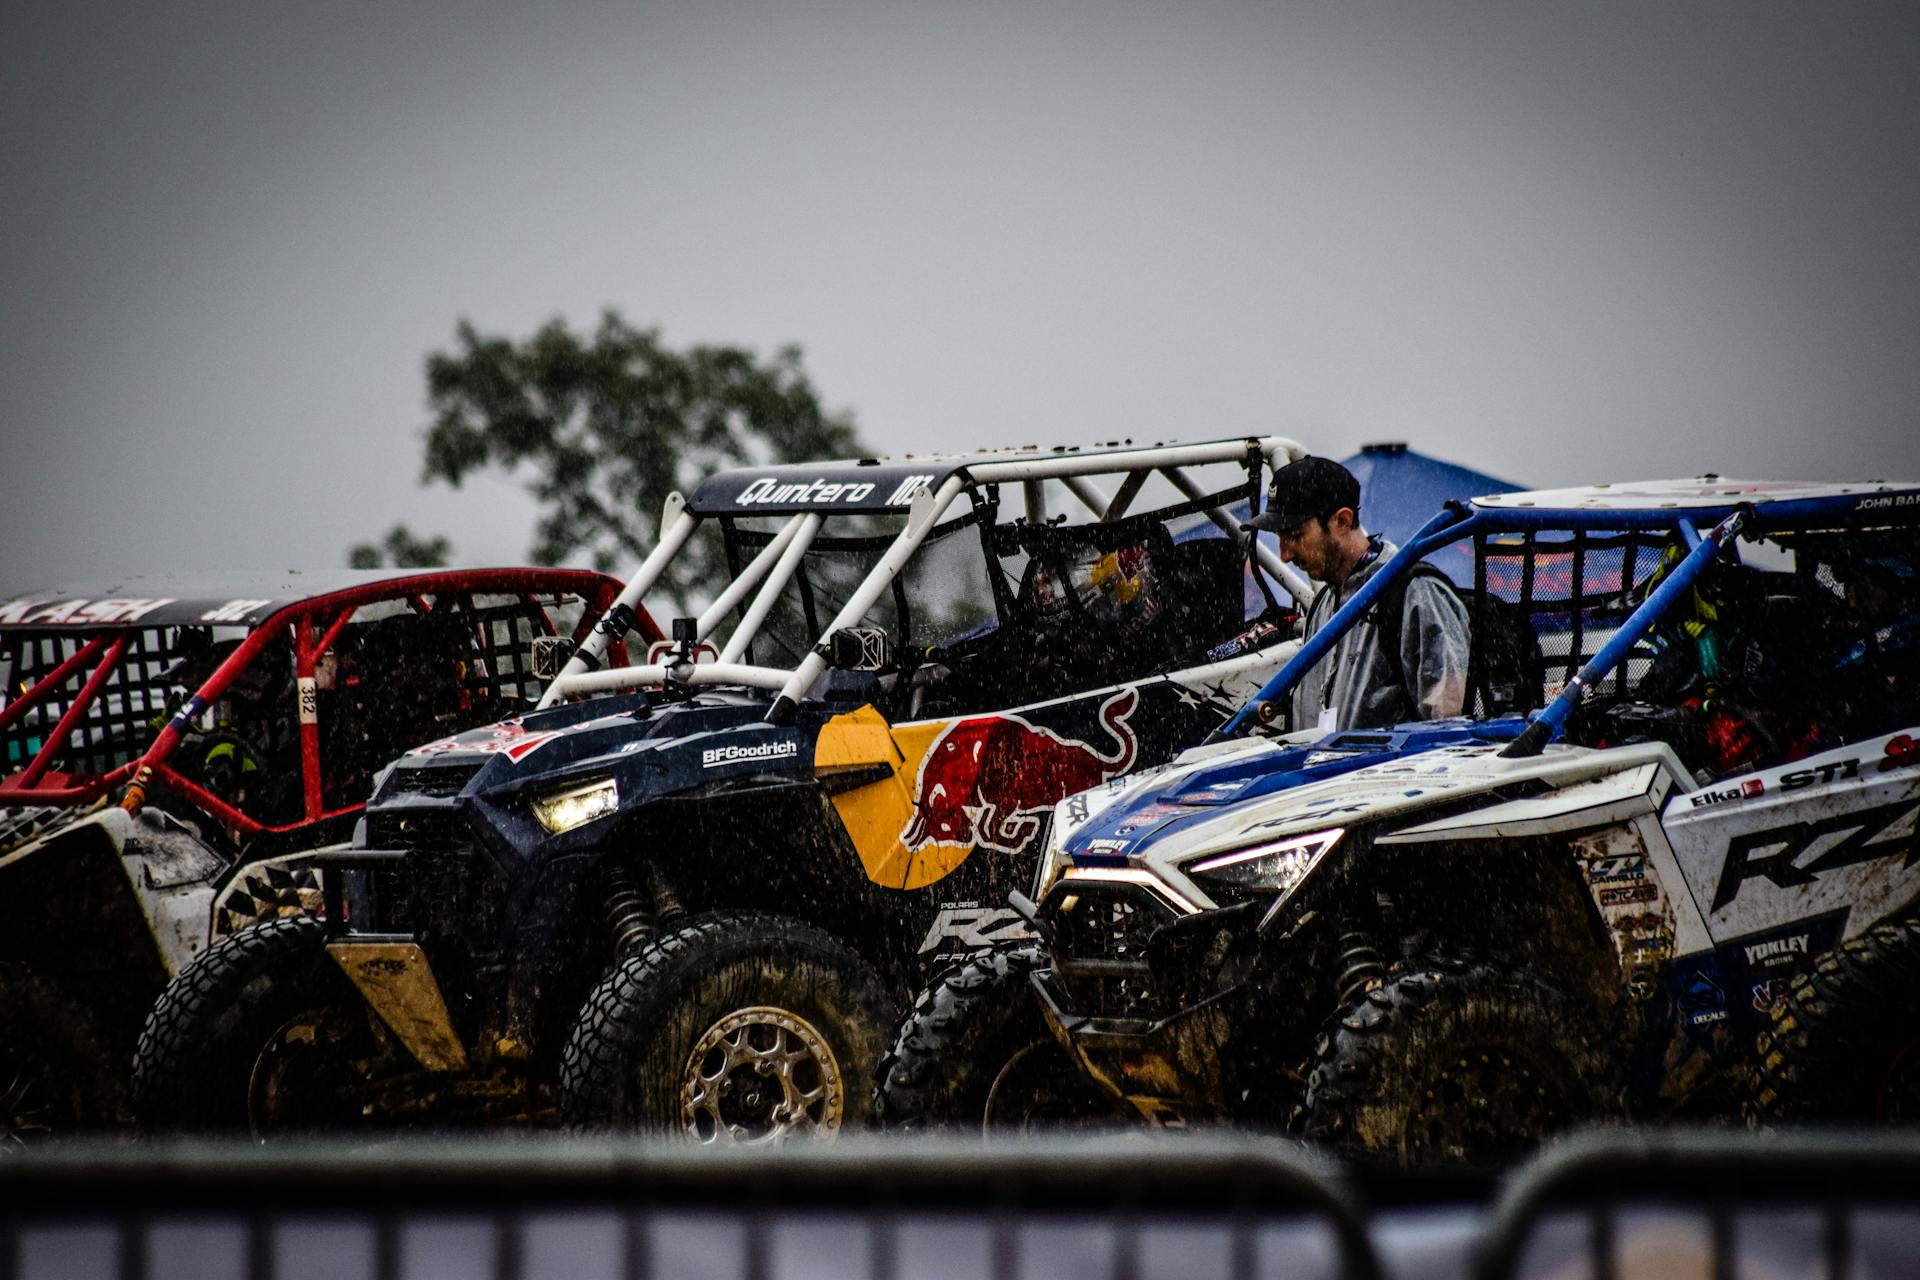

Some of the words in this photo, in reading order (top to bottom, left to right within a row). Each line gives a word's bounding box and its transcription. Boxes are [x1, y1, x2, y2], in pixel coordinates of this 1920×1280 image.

[735, 478, 876, 506] Quintero
[1855, 497, 1893, 511] JOHN
[302, 687, 316, 714] 382
[702, 740, 797, 764] BFGoodrich
[1690, 788, 1742, 807] Elka
[1780, 758, 1860, 792] STI
[1710, 798, 1920, 914] RZ
[940, 901, 978, 909] POLARIS
[1743, 933, 1809, 966] YOKLEY
